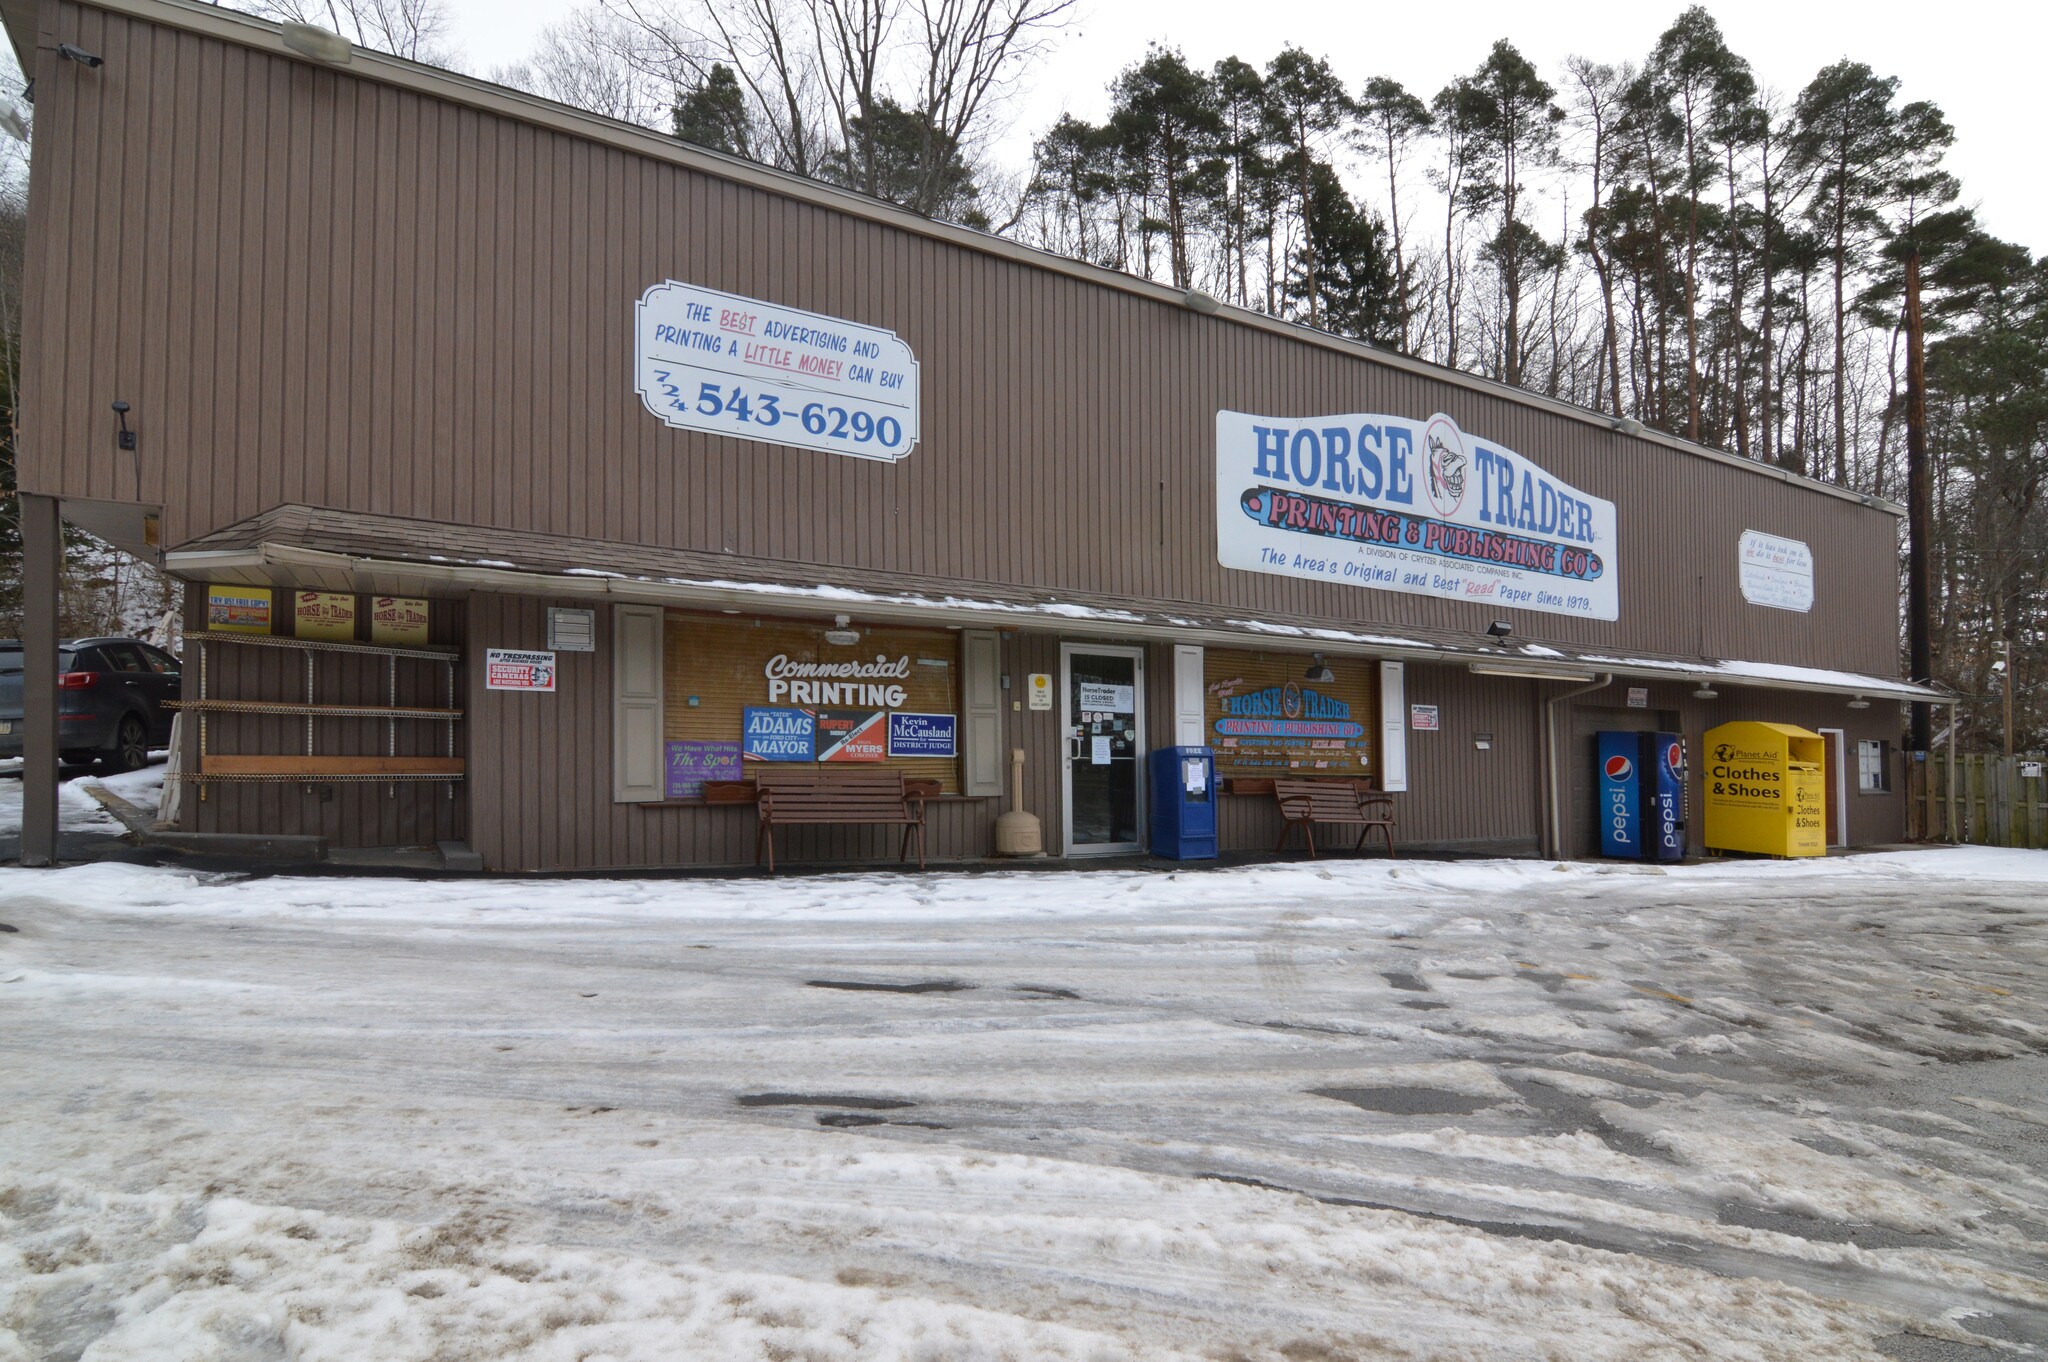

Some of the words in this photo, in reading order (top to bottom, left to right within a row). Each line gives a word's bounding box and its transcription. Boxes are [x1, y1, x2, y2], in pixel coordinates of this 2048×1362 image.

[686, 302, 712, 322] THE
[720, 309, 757, 332] BEST
[764, 320, 847, 353] ADVERTISING
[853, 340, 880, 359] AND
[655, 324, 721, 353] PRINTING
[728, 340, 738, 357] A
[744, 345, 791, 366] LITTLE
[799, 354, 843, 377] MONEY
[848, 365, 874, 384] CAN
[880, 371, 904, 390] BUY
[696, 382, 902, 448] 543-6290
[1253, 423, 1413, 505] HORSE
[1475, 446, 1595, 543] TRADER
[1269, 493, 1401, 544] PRINTING
[1405, 521, 1420, 544] &
[1424, 522, 1555, 571] PUBLISHING
[1358, 546, 1364, 554] A
[1366, 547, 1396, 560] DIVISION
[1399, 552, 1409, 561] OF
[1411, 554, 1437, 566] CRYTZER
[1439, 559, 1475, 573] ASSOCIATED
[1477, 565, 1510, 578] COMPANIES
[1261, 547, 1287, 567] The
[1293, 554, 1338, 574] Area's
[1343, 561, 1397, 582] Original
[1403, 572, 1428, 588] and
[1433, 574, 1461, 592] Best
[1500, 585, 1533, 602] Paper
[1537, 591, 1563, 607] Since
[297, 603, 320, 616] HORSE
[331, 604, 353, 618] TRADER
[374, 609, 396, 621] HORSE
[406, 609, 427, 623] TRADER
[503, 653, 554, 661] TRESPASSING
[492, 665, 530, 673] SECURITY
[765, 654, 910, 680] Commercial
[769, 679, 907, 707] PRINTING
[1230, 688, 1282, 716] HORSE
[1303, 689, 1350, 719] TRADER
[748, 716, 812, 735] ADAMS
[820, 720, 854, 730] RUPERT
[901, 716, 928, 726] Kevin
[1225, 720, 1274, 734] PRINTING
[1284, 722, 1340, 735] PUBLISHING
[840, 728, 863, 746] Re-Elect
[894, 724, 952, 738] McCausland
[752, 740, 808, 754] MAYOR
[846, 745, 883, 753] MYERS
[672, 752, 697, 766] The
[702, 753, 737, 769] Spot
[1712, 766, 1780, 782] Clothes
[1712, 782, 1725, 794] &
[1728, 783, 1780, 798] Shoes
[1609, 788, 1630, 843] pepsi
[1660, 793, 1676, 848] pepsi
[1796, 818, 1801, 828] &
[1802, 818, 1820, 828] Shoes
